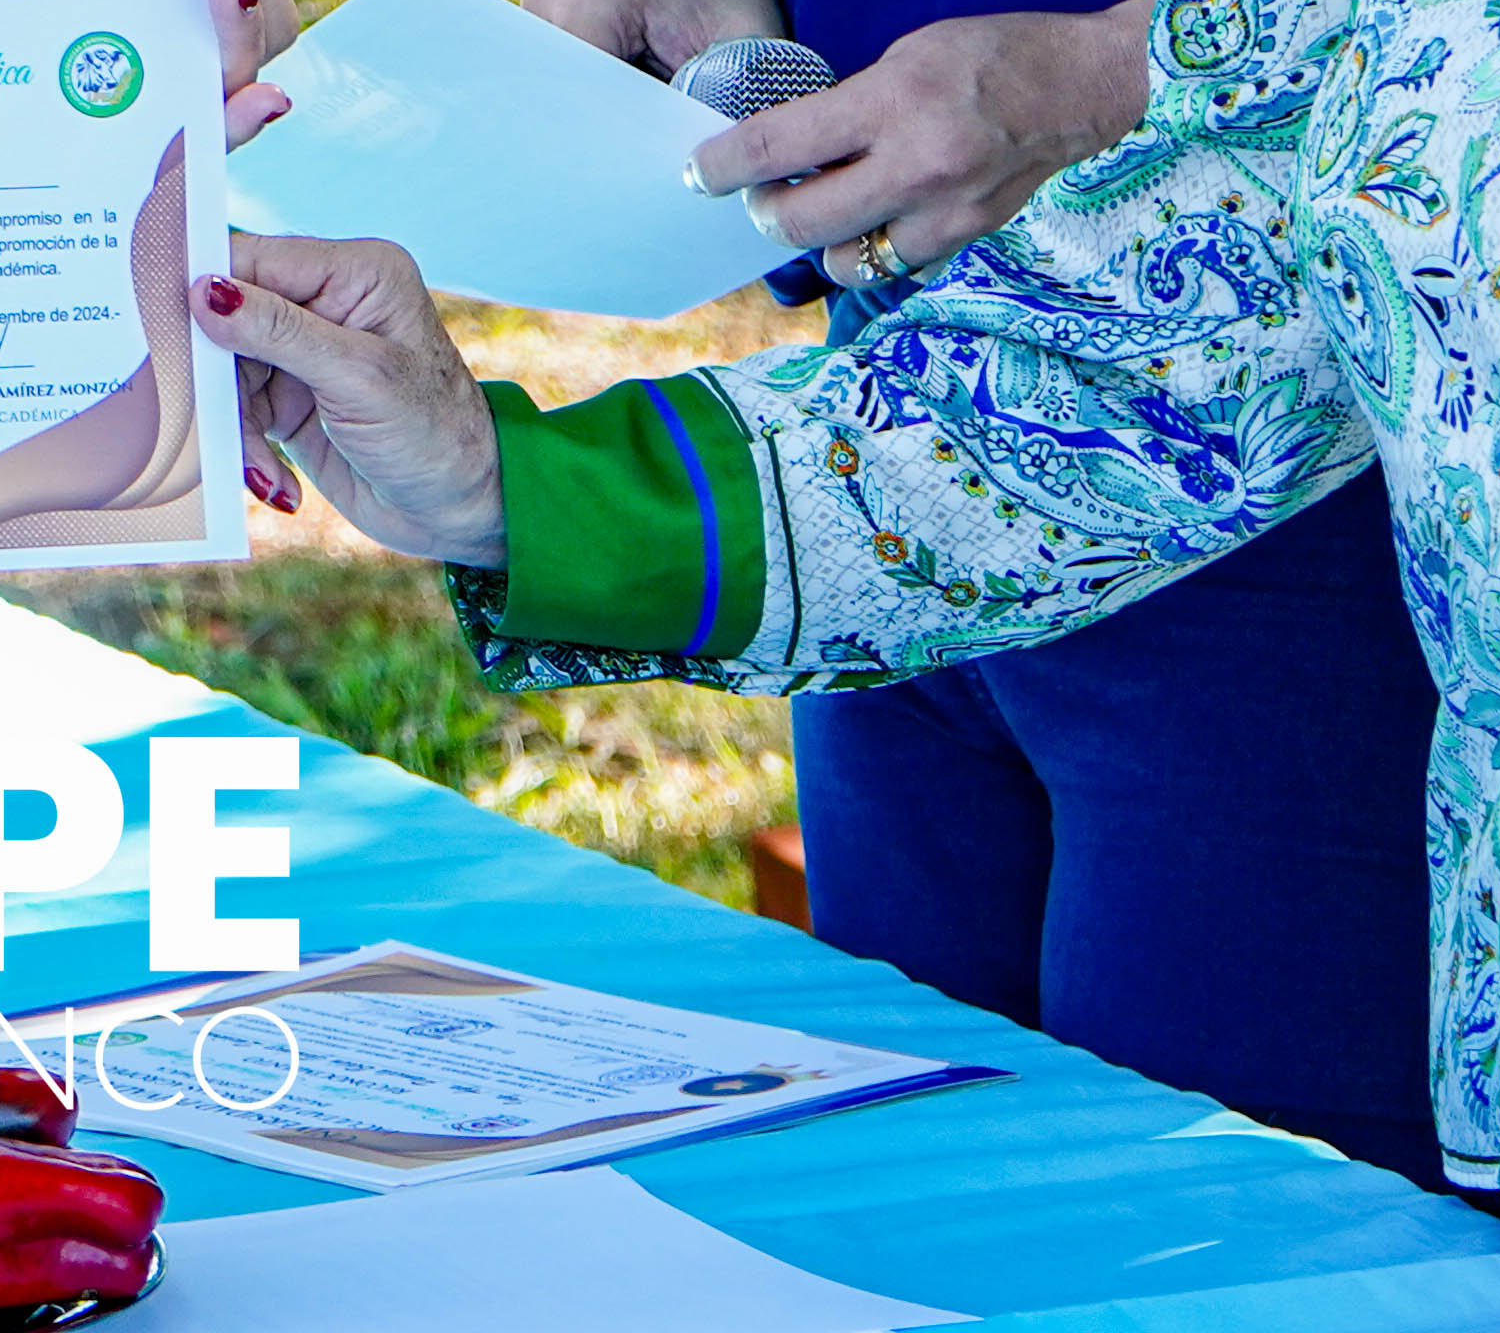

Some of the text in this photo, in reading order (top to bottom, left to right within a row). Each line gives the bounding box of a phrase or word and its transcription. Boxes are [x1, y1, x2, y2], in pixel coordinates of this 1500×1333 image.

[74, 212, 92, 224] en
[104, 209, 117, 223] la
[80, 235, 100, 249] de
[105, 234, 118, 248] la
[50, 308, 69, 322] de
[73, 306, 121, 321] 2024.-
[60, 378, 133, 396] MONZÓN
